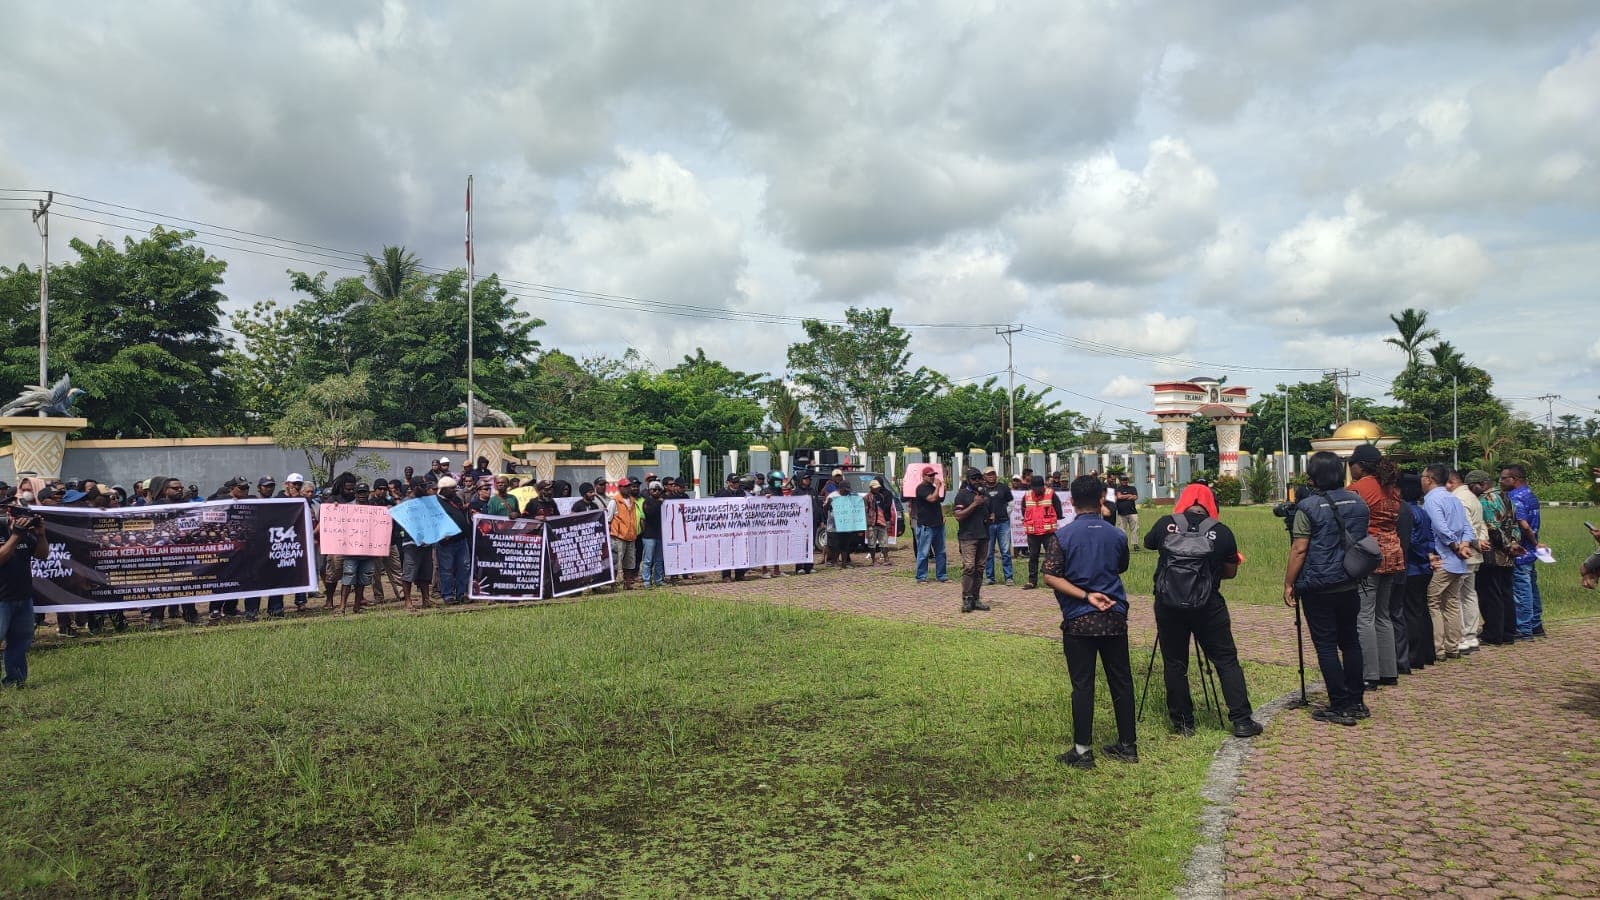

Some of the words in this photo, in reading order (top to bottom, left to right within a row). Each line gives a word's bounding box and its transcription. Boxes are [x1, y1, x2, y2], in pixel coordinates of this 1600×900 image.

[678, 505, 706, 514] KORBAN
[730, 512, 743, 520] TAK
[745, 511, 776, 520] SEBANDING
[776, 510, 800, 518] DENGAN
[695, 522, 726, 531] RATUSAN
[727, 519, 750, 529] NYAWA
[751, 519, 766, 528] YANG
[269, 525, 297, 543] 134
[169, 545, 216, 553] DINYATAKAN
[271, 541, 301, 551] ORANG
[552, 543, 578, 553] JANGAN
[269, 549, 304, 560] KORBAN
[277, 558, 297, 568] JIWA
[477, 560, 508, 568] KERABAT
[560, 562, 575, 570] JADI
[31, 568, 73, 578] PASTIAN
